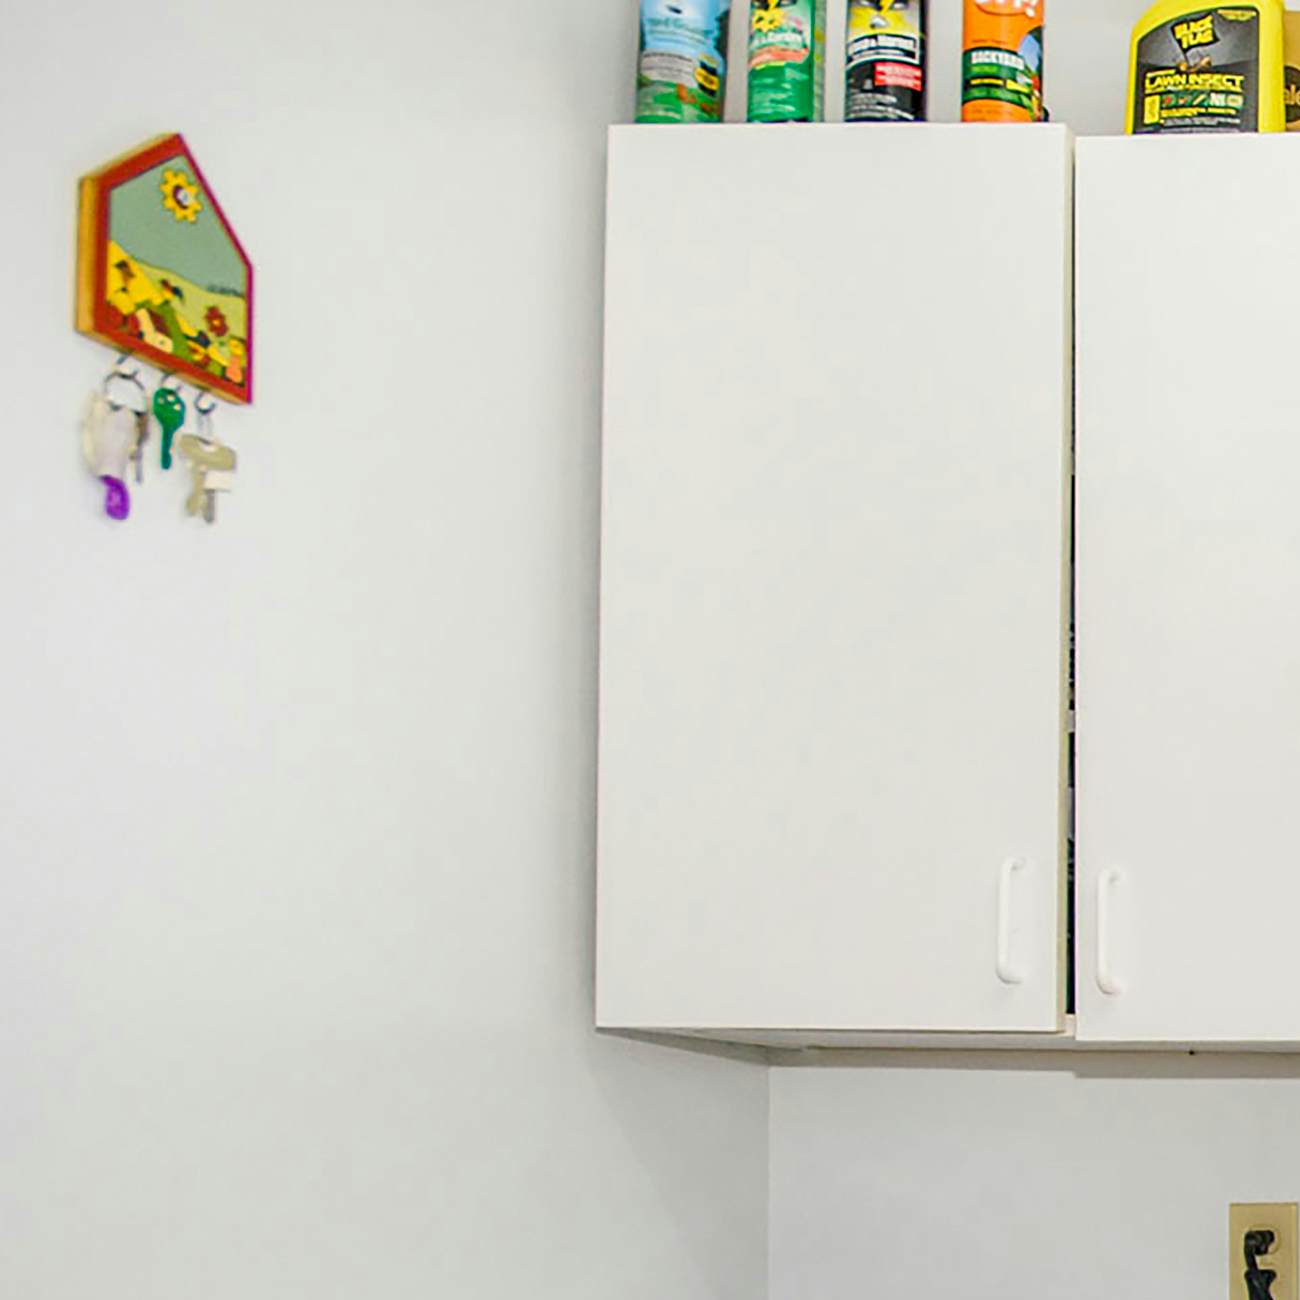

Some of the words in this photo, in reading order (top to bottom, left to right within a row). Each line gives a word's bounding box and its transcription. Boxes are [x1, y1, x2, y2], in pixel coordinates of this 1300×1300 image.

[1174, 15, 1213, 39] BLACK
[1180, 30, 1213, 48] FLAG
[1145, 74, 1186, 89] LAWN
[1189, 74, 1244, 87] INSECT
